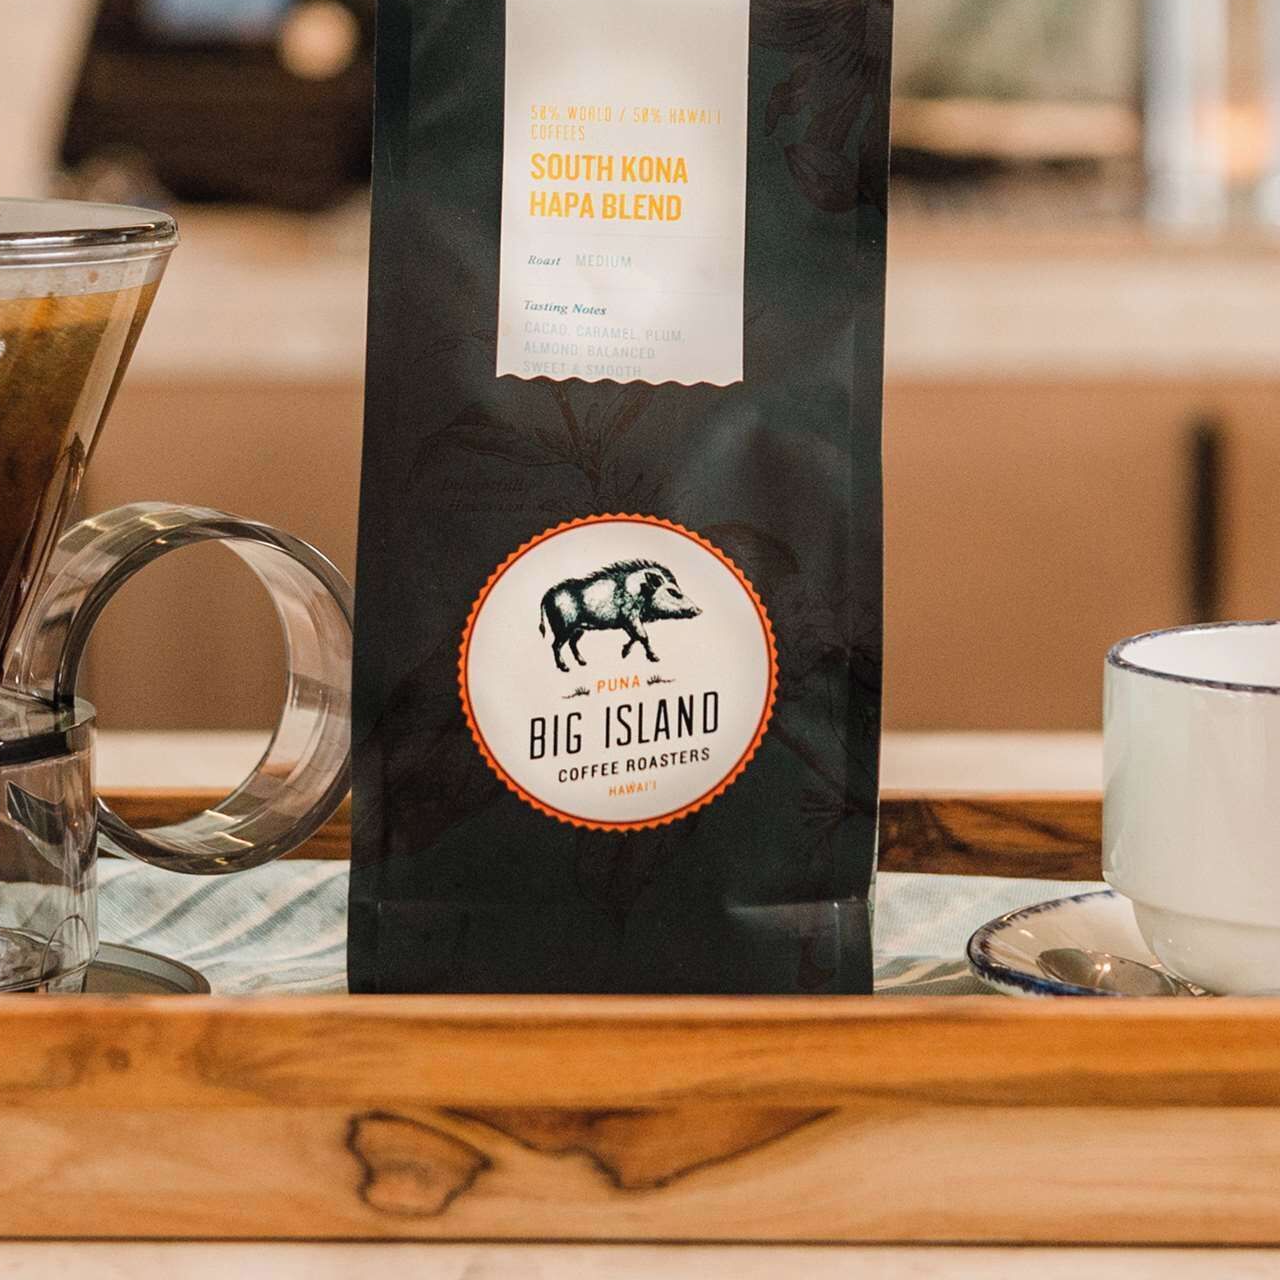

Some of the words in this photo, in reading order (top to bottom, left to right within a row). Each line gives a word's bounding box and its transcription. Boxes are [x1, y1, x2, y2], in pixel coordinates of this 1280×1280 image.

[567, 107, 612, 122] WORLD
[530, 125, 586, 141] COFFEES
[531, 152, 614, 181] SOUTH
[621, 155, 688, 184] KONA
[529, 191, 595, 219] HAPA
[601, 193, 683, 221] BLEND
[528, 255, 561, 267] Roast
[575, 254, 633, 268] MEDIUM
[524, 300, 568, 315] Tasting
[573, 304, 608, 316] Notes
[596, 675, 641, 694] PUNA
[529, 712, 582, 760] BIG
[604, 691, 719, 749] ISLAND
[558, 761, 620, 783] COFFEE
[626, 747, 711, 772] ROASTERS
